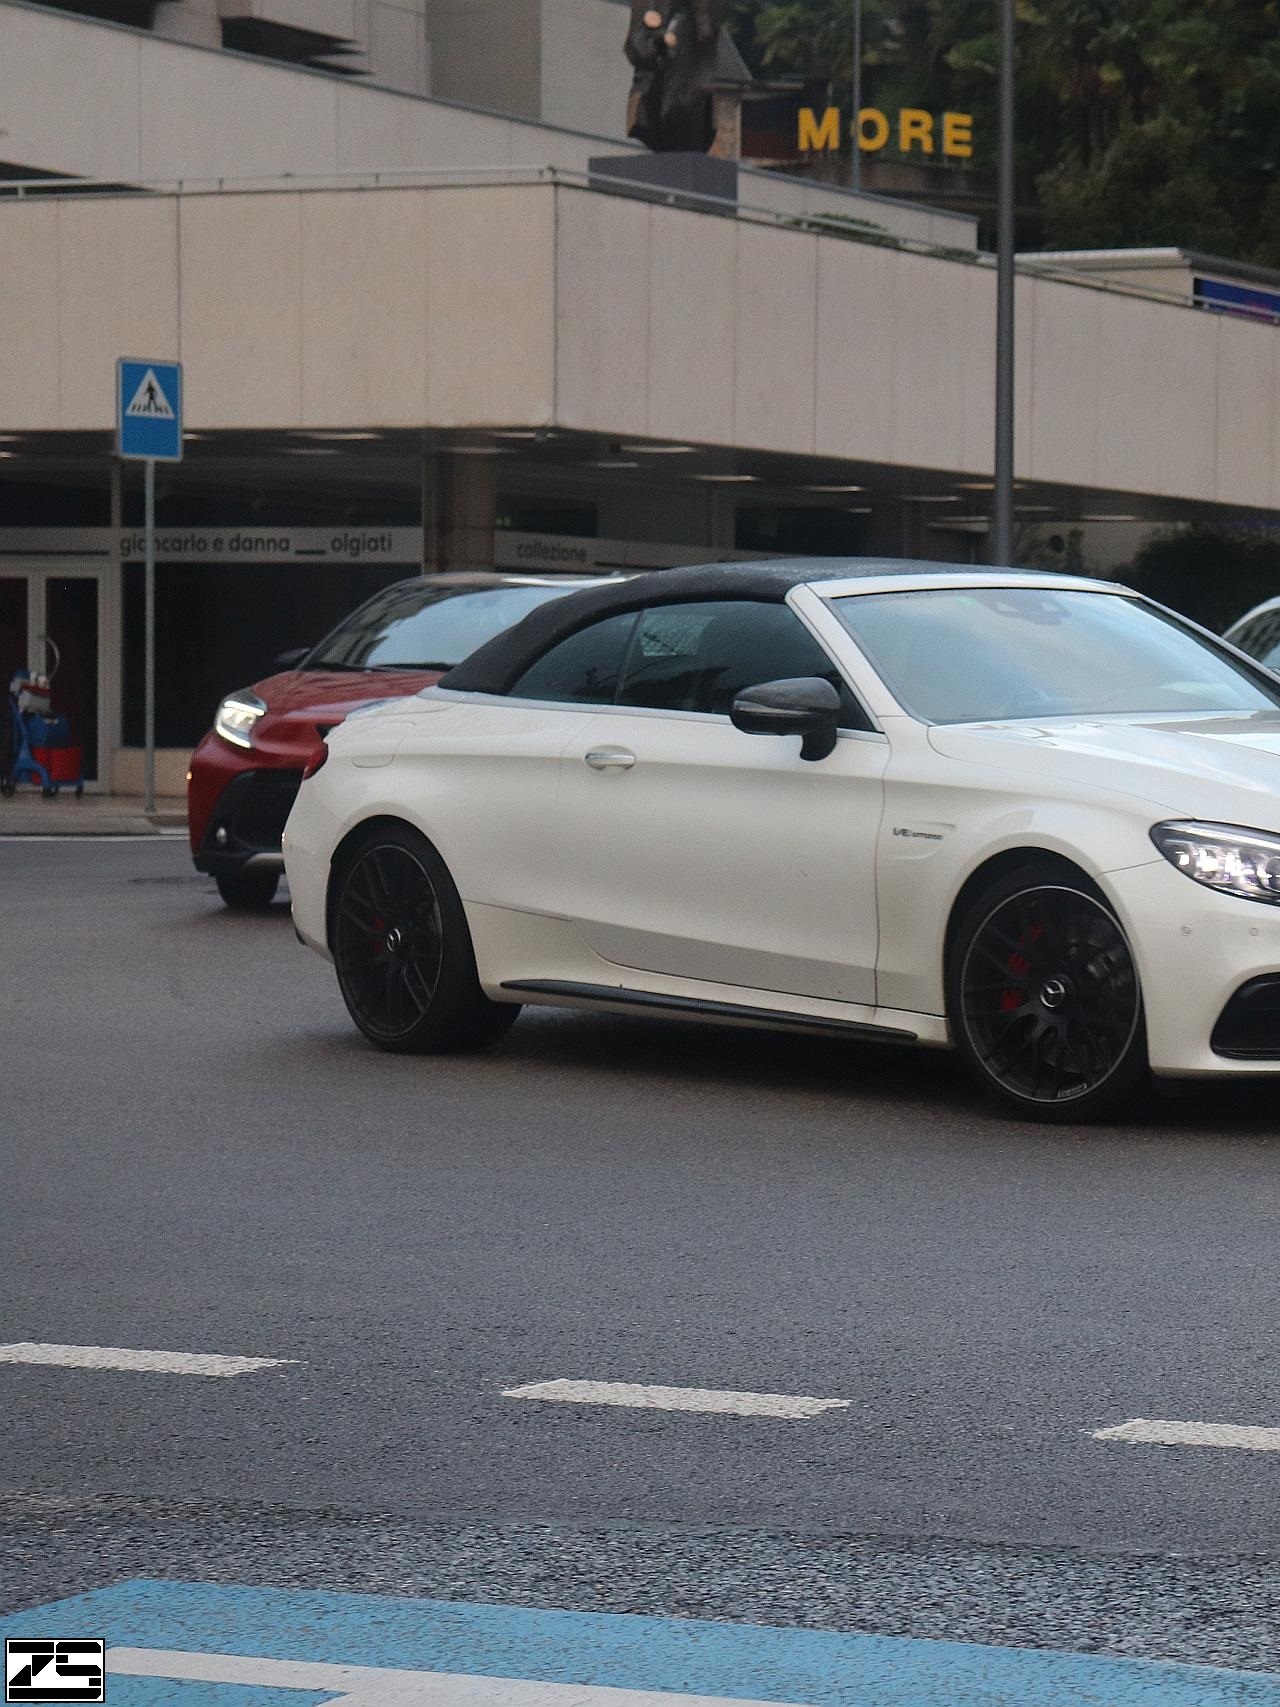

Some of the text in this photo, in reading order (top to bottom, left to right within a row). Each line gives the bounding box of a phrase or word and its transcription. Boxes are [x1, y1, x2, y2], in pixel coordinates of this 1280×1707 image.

[797, 106, 974, 158] MORE
[119, 532, 393, 558] giancarlo e danna olgiati
[516, 539, 587, 563] collezione
